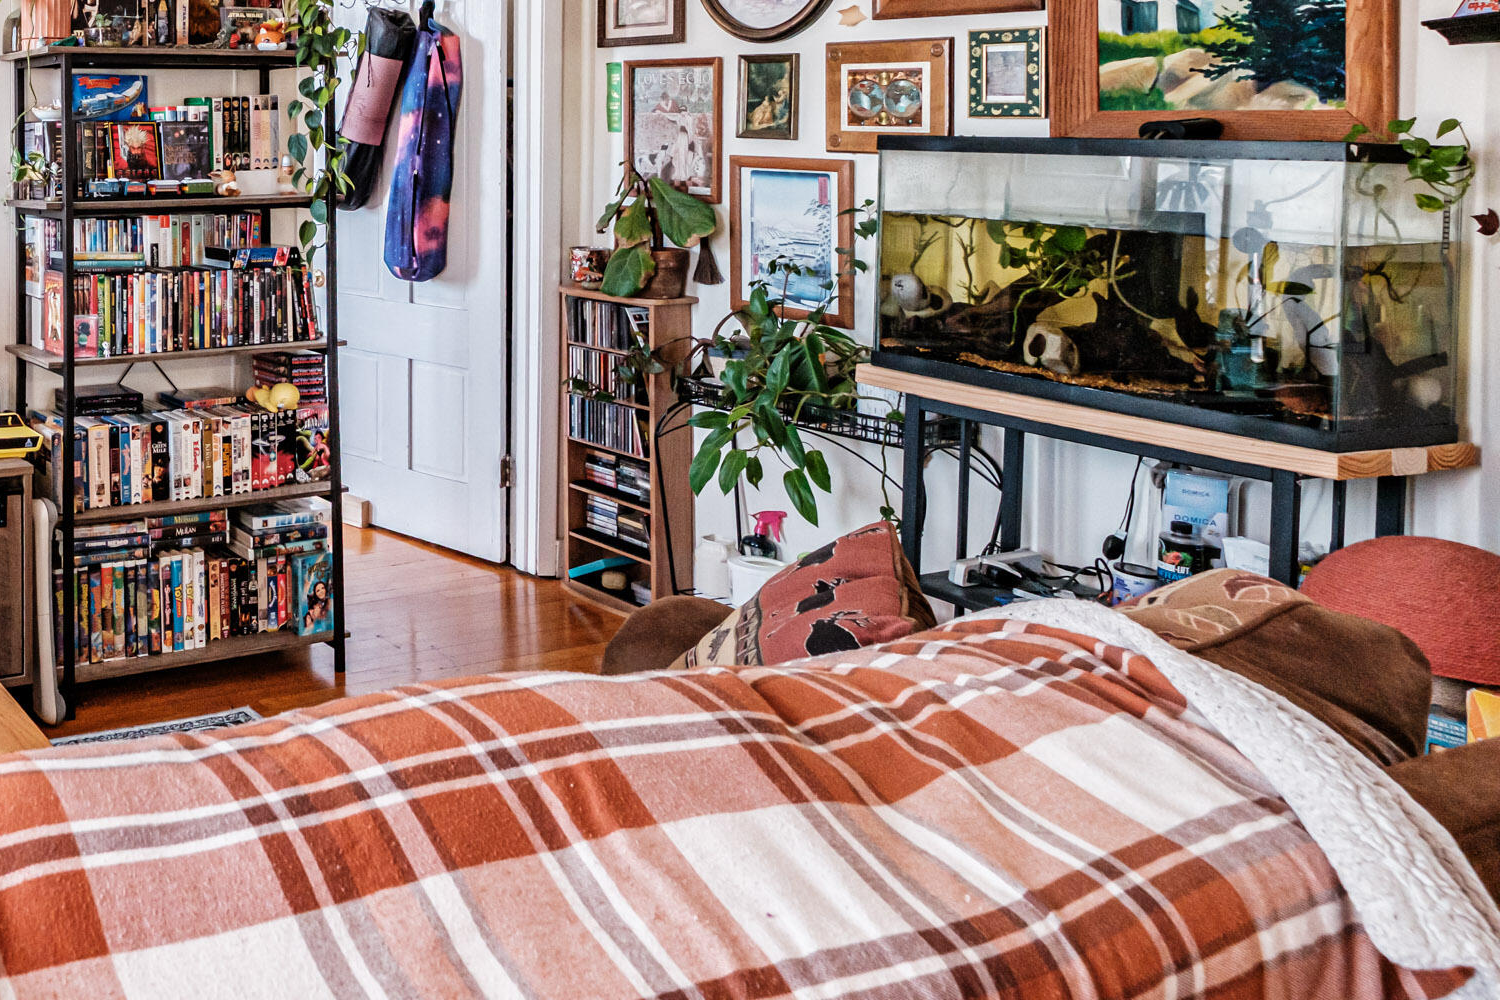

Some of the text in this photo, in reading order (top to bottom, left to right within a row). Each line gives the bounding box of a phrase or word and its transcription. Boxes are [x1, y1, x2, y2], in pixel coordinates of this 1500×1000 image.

[1181, 488, 1210, 498] DOMICA
[1174, 514, 1217, 527] DOMICA
[175, 526, 197, 537] MULAN
[174, 584, 182, 602] TOY
[185, 581, 193, 600] TOY
